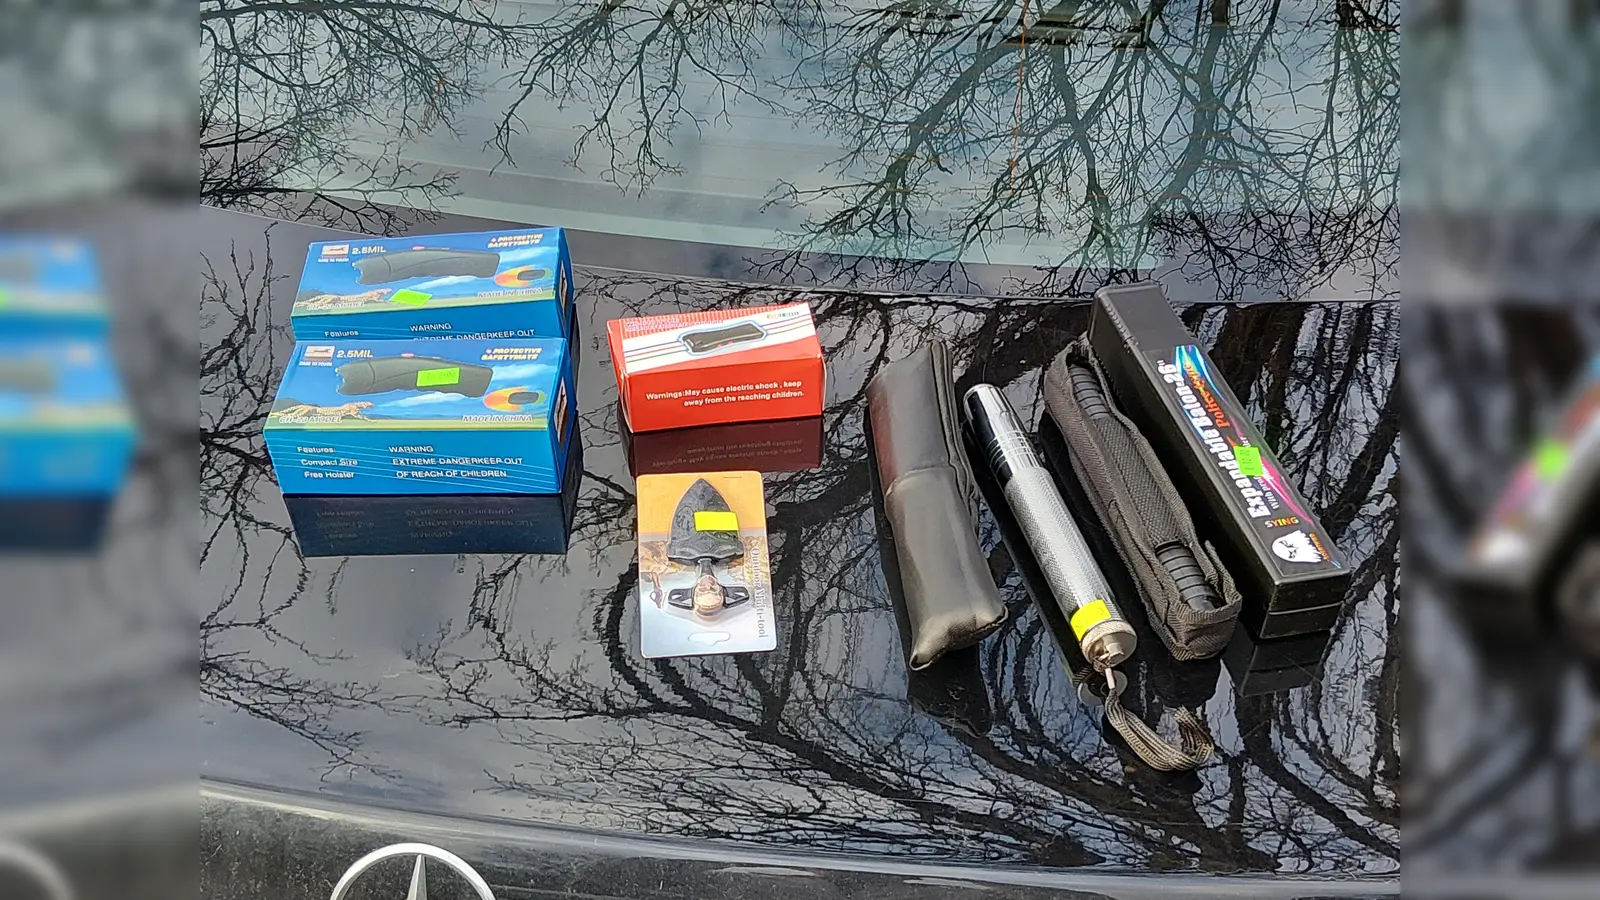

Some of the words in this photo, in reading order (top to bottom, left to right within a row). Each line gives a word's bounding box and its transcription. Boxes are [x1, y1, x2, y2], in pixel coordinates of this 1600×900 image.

[409, 322, 452, 332] WARNING
[516, 329, 535, 337] OUT
[336, 349, 374, 358] 2.5MIL
[702, 387, 725, 395] cause
[725, 385, 754, 393] electric
[755, 382, 778, 390] shock
[783, 380, 802, 389] keep
[683, 399, 704, 407] away
[704, 397, 723, 405] from
[723, 395, 737, 403] the
[737, 393, 771, 402] reaching
[771, 389, 805, 399] children.
[461, 414, 489, 422] MADE
[489, 414, 501, 422] IN
[501, 414, 533, 422] CHINA
[388, 445, 434, 453] WARNING
[300, 458, 338, 467] Compact
[339, 458, 358, 466] Size
[392, 458, 437, 466] EXTREME
[503, 457, 523, 465] OUT
[396, 470, 410, 478] OF
[411, 470, 443, 478] REACH
[1203, 428, 1272, 518] Expandable
[1264, 491, 1280, 510] With
[1264, 516, 1300, 528] SYING
[752, 548, 761, 588] Outdoor
[755, 588, 768, 638] Multi-tool
